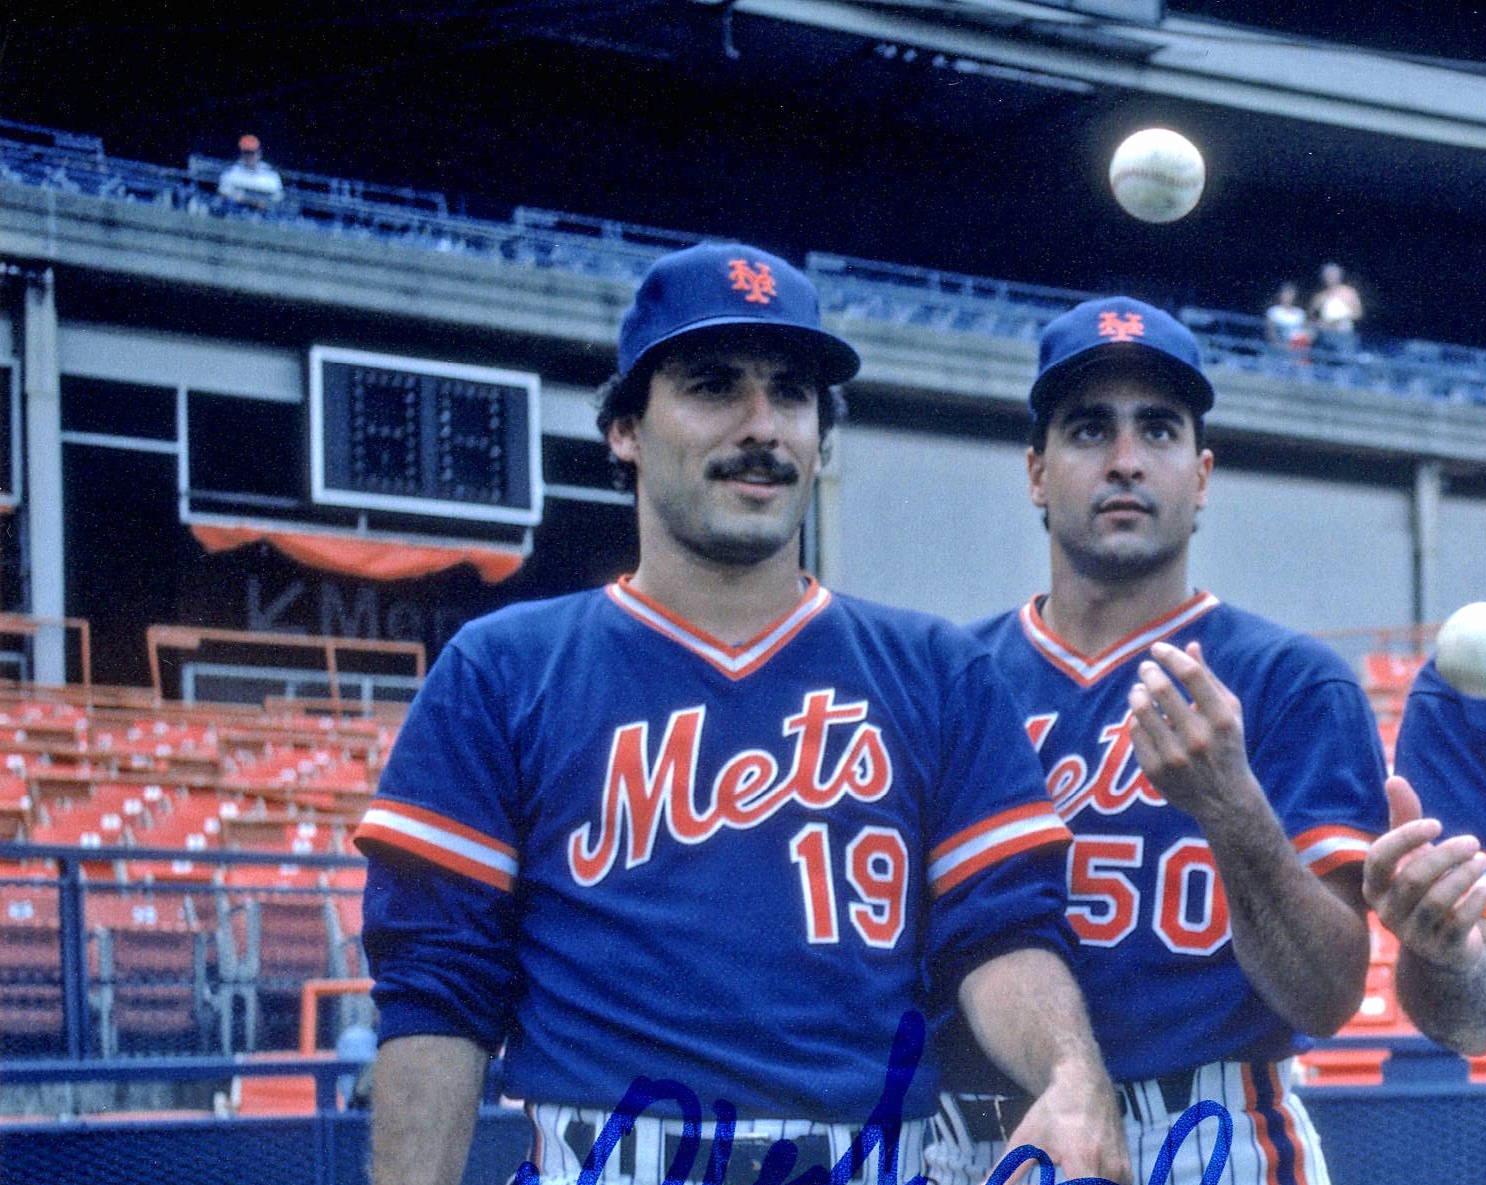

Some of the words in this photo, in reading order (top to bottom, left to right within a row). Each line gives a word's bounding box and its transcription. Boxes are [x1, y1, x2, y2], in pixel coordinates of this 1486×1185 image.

[568, 688, 893, 887] Mets
[1026, 711, 1167, 823] et
[790, 822, 910, 950] 19
[1065, 834, 1232, 957] 50
